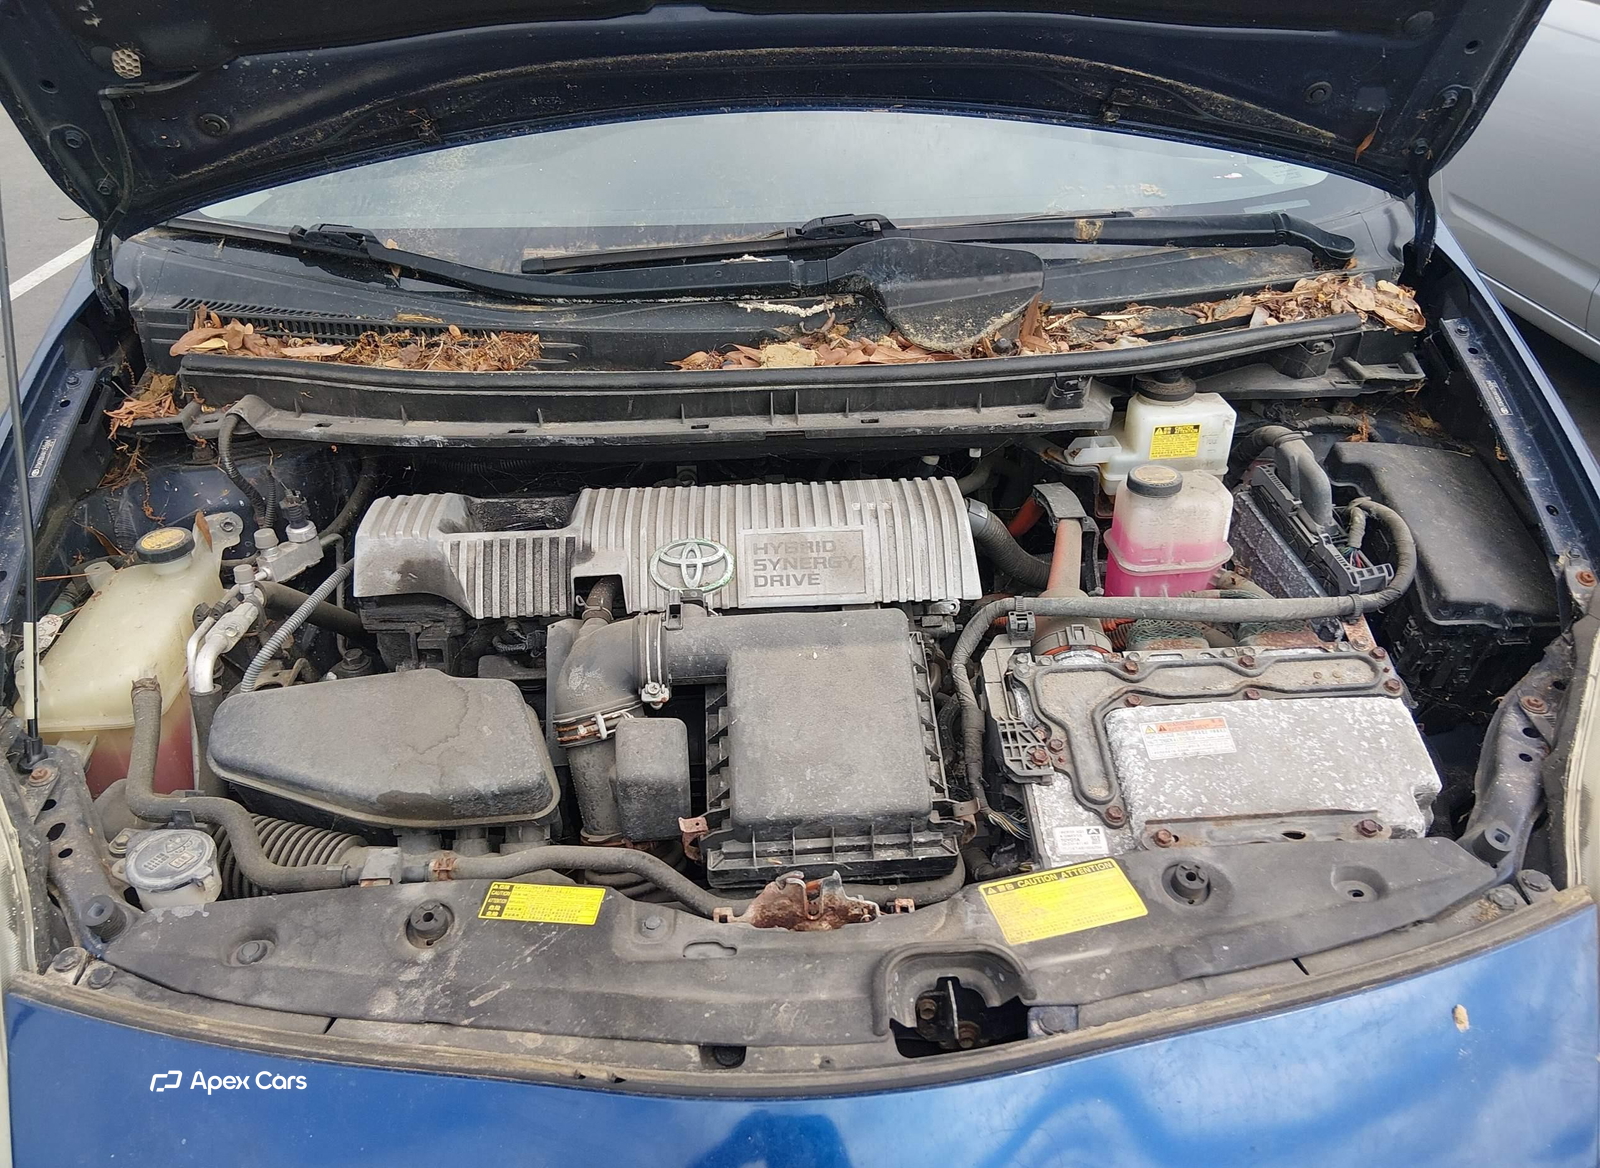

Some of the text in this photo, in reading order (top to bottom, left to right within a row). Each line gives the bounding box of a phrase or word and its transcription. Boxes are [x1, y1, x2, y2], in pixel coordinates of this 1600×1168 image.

[752, 540, 837, 555] HYBRID
[753, 555, 861, 571] SYNERGY
[753, 573, 821, 588] DRIVE
[1017, 874, 1058, 888] CAUTION
[1058, 862, 1113, 878] ATTENTION
